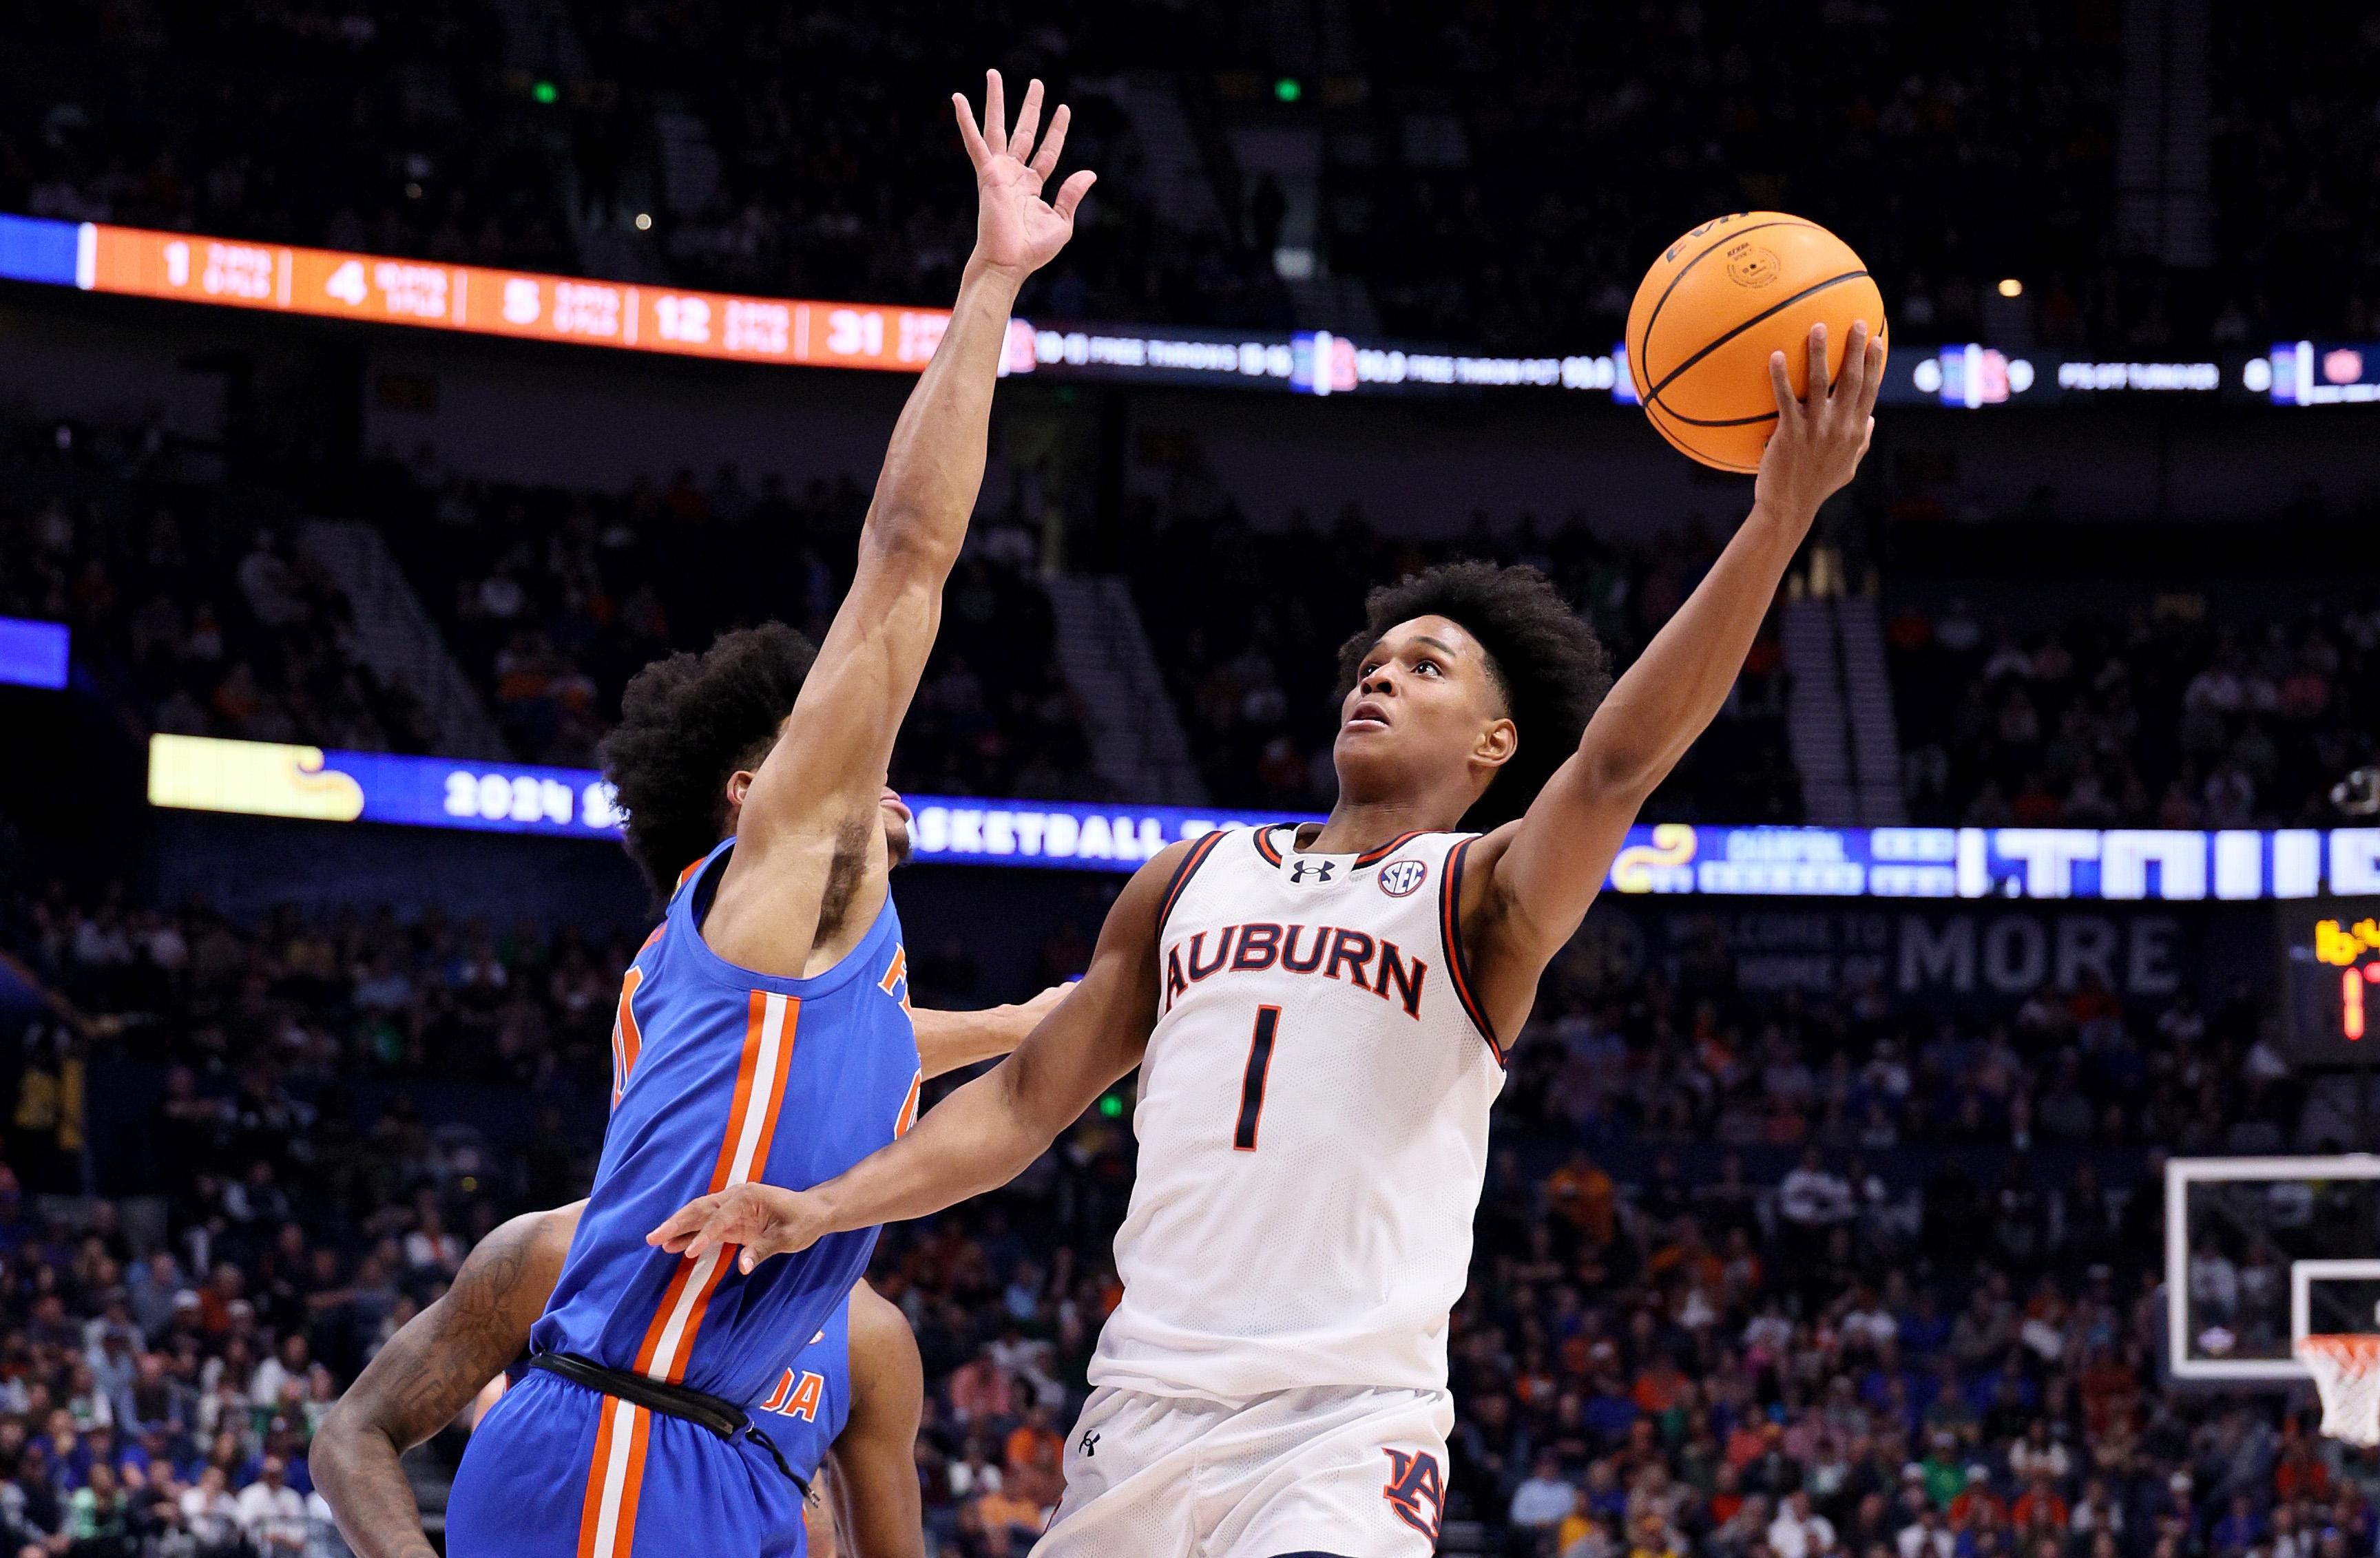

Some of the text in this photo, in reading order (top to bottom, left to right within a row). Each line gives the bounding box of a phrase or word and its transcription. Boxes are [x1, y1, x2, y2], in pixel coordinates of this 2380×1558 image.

[325, 260, 368, 306] 4
[908, 806, 1165, 862] SKETBALL
[1382, 861, 1423, 894] SEC
[1165, 923, 1428, 1022] AUBURN
[1897, 912, 2181, 994] MORE
[1233, 1004, 1282, 1152] 1
